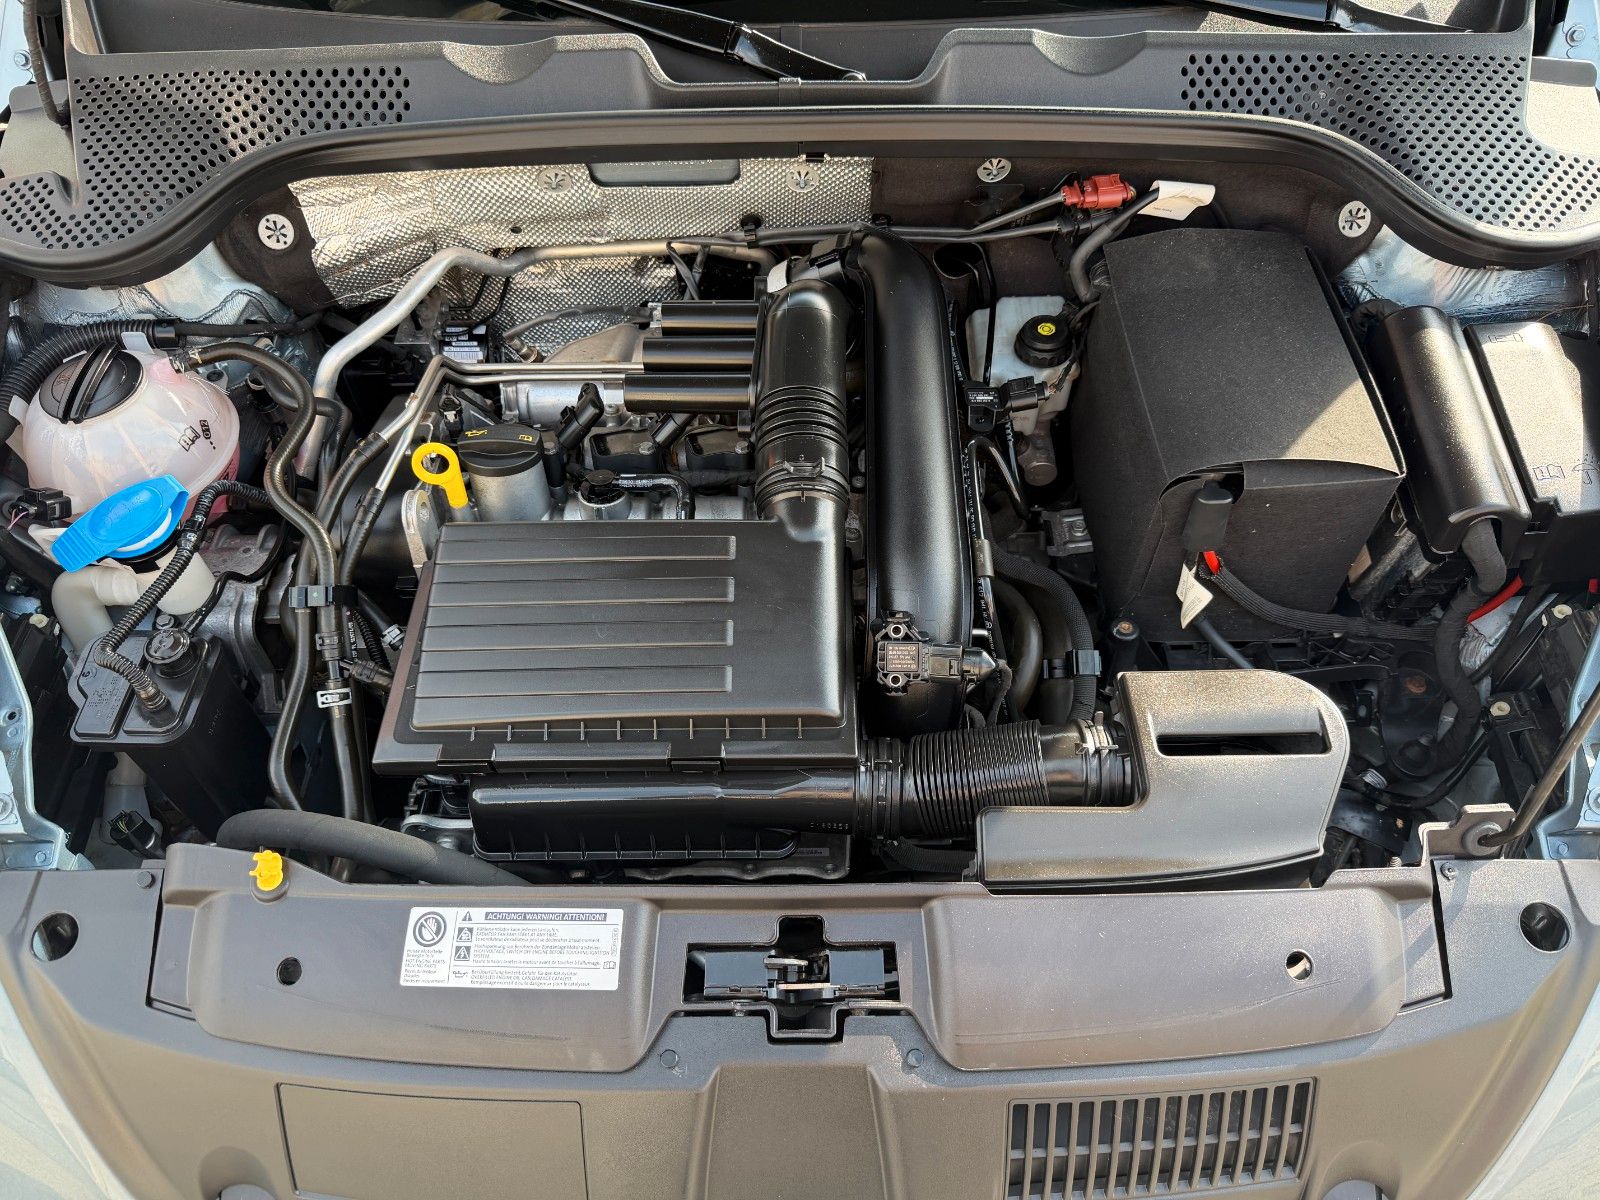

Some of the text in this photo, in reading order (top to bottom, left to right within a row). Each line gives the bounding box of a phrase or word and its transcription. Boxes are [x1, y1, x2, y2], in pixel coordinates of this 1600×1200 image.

[487, 912, 605, 922] ACHTUNG! WARNING! ATTENTION!
